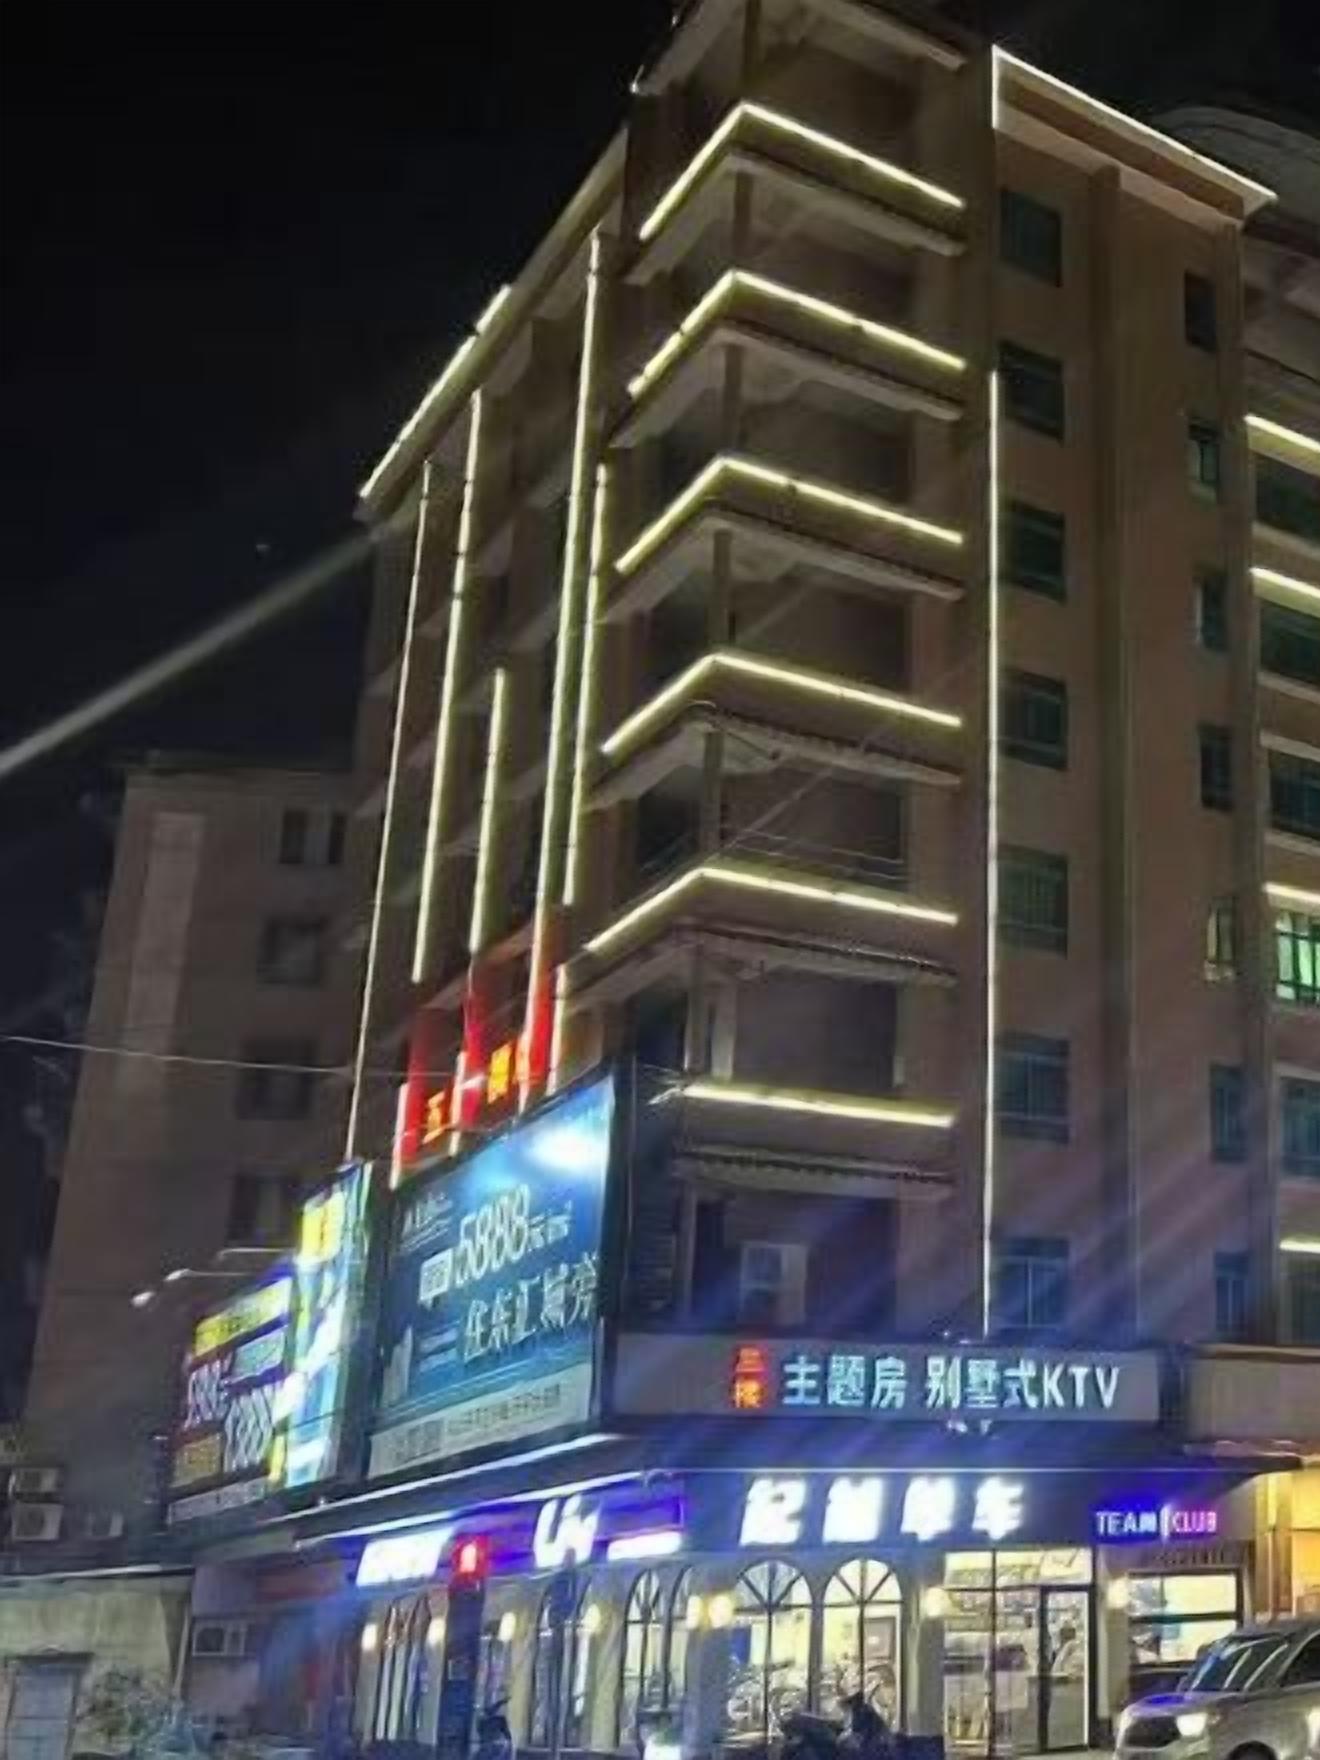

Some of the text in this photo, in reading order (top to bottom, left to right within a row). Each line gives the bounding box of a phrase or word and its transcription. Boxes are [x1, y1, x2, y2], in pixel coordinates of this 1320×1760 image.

[782, 1355, 907, 1409] 主题房
[925, 1355, 1120, 1409] 别墅式KTV
[1096, 1510, 1218, 1536] TEAM CLUB
